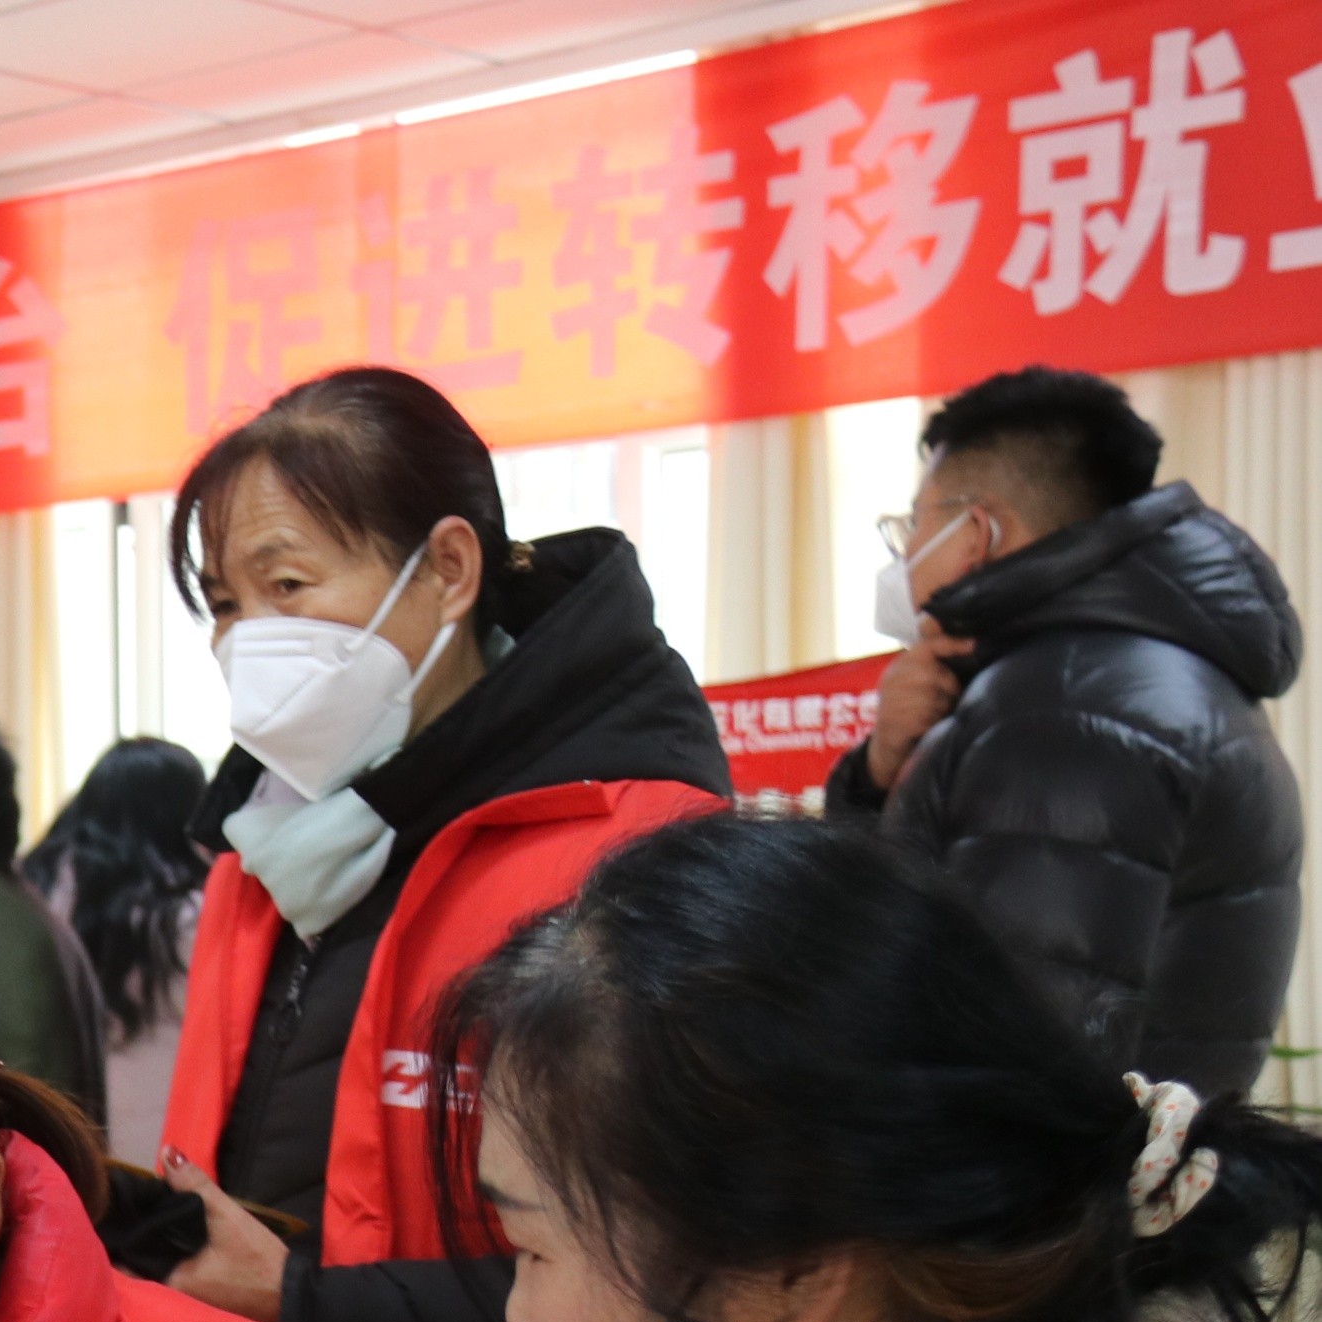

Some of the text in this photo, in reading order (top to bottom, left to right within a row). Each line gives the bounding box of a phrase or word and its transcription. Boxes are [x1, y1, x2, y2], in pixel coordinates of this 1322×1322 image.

[164, 27, 1322, 438] 促进转移就
